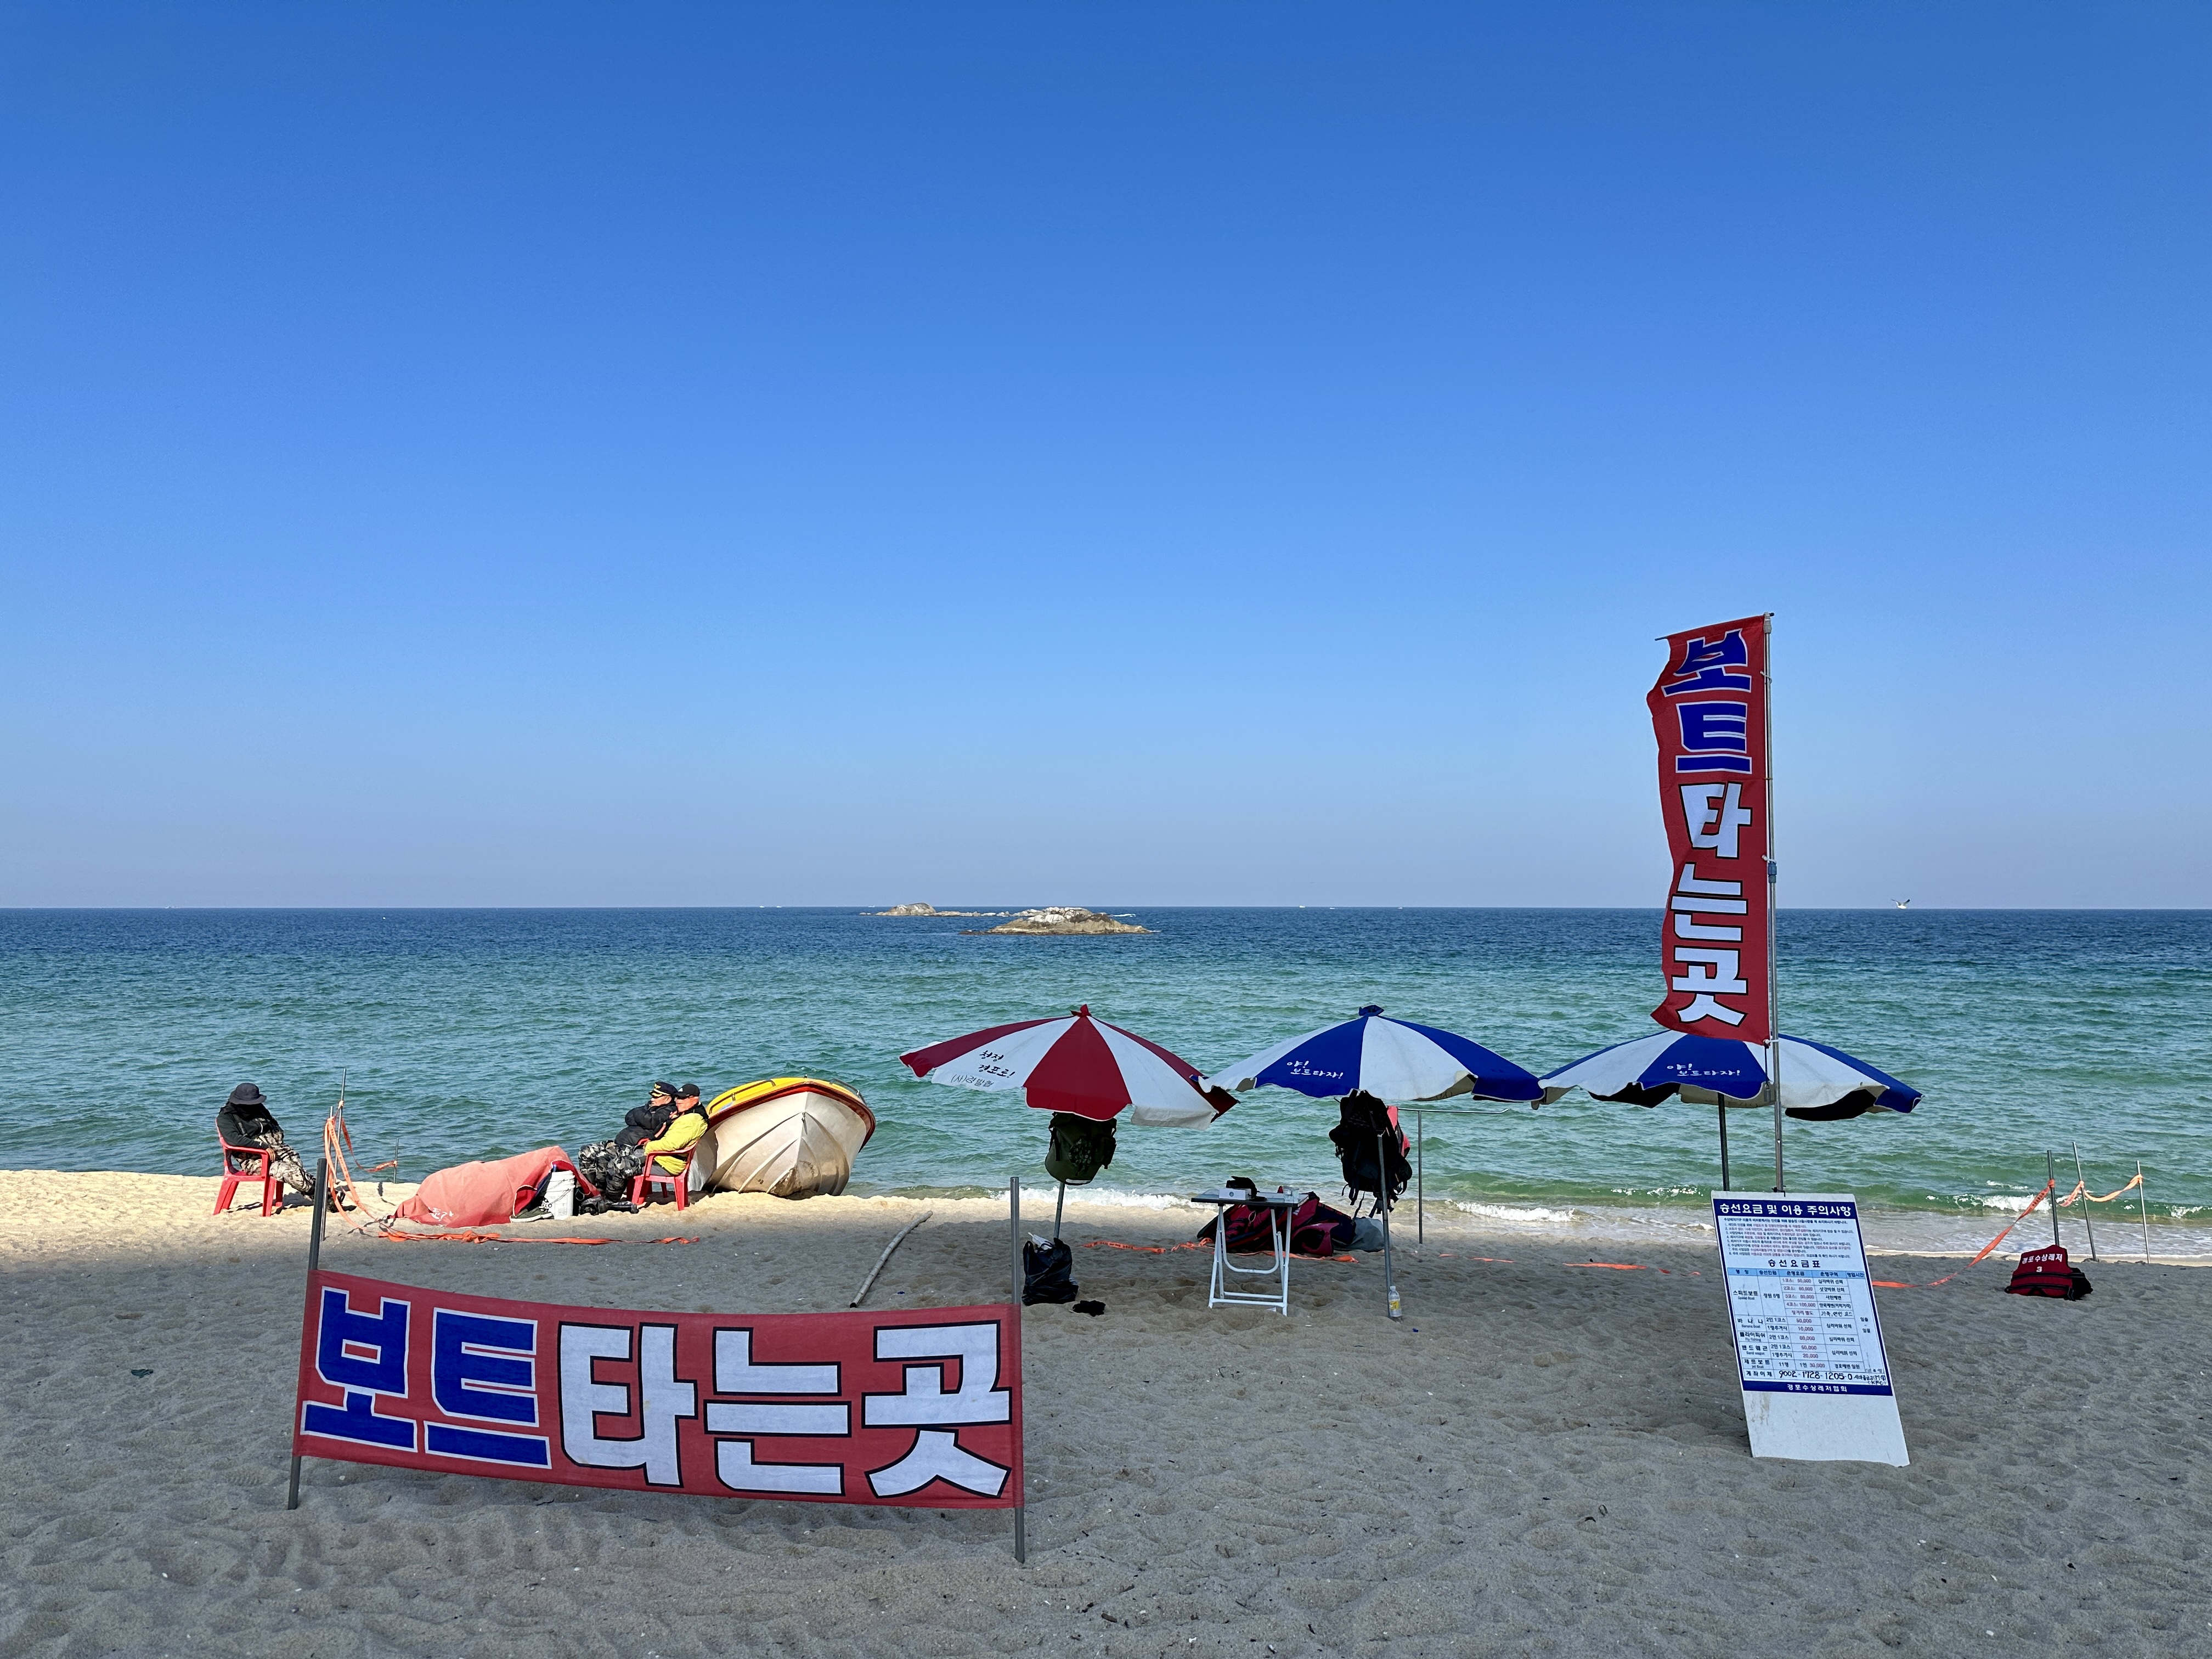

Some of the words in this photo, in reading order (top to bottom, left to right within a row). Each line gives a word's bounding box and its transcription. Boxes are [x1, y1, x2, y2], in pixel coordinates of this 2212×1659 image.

[979, 1050, 1004, 1062] 청정
[978, 1064, 1015, 1078] 경포로!
[1720, 1203, 1763, 1214] 승선요금
[1767, 1205, 1777, 1215] 및
[1781, 1205, 1803, 1215] 이용
[1807, 1205, 1851, 1216] 주의사항
[1768, 1259, 1820, 1268] 승선요금표
[2022, 1254, 2062, 1265] 경포수상레저
[1787, 1384, 1847, 1392] 경포수상레저협회
